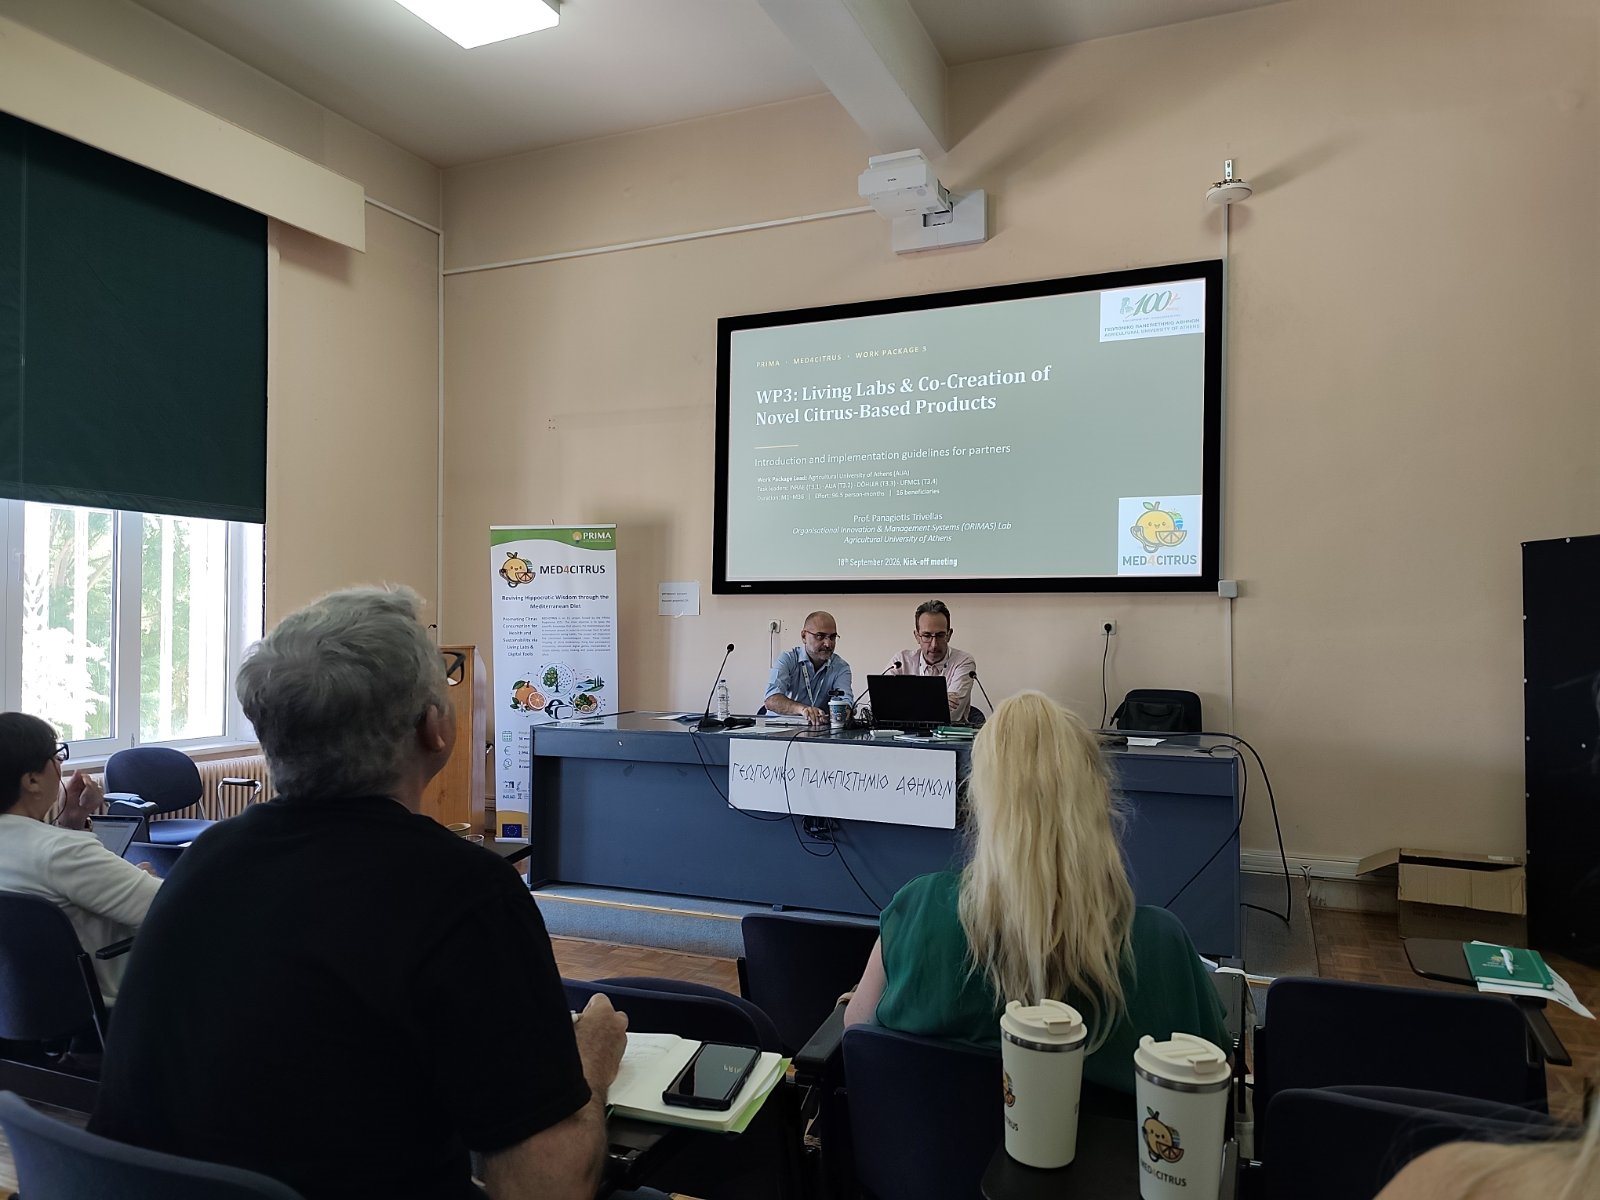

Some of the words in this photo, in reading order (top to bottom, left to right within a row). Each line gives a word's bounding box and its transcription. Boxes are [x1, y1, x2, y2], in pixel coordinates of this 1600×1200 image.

[856, 351, 880, 359] WORK
[882, 346, 919, 356] PACKAGE
[756, 388, 798, 404] WP3:
[802, 385, 852, 402] Living
[856, 380, 896, 397] Labs
[900, 378, 914, 393] &
[918, 370, 1026, 392] Co-Creation
[1031, 364, 1052, 382] of
[756, 409, 799, 426] Novel
[804, 400, 911, 422] Citrus-Based
[916, 395, 997, 414] Products
[754, 456, 807, 467] Introduction
[809, 454, 826, 464] and
[827, 450, 900, 464] implementation
[902, 448, 950, 460] guidelines
[952, 446, 967, 456] for
[968, 444, 1011, 457] partners
[808, 473, 838, 482] Agricultural
[854, 514, 870, 522] Prof.
[872, 514, 910, 522] Panagiotis
[912, 512, 943, 520] Trivellas
[792, 526, 840, 536] Organisational
[840, 526, 876, 534] Innovation
[884, 524, 930, 533] Management
[932, 524, 960, 532] Systems
[960, 522, 997, 532] (ORIMAS)
[998, 521, 1012, 530] Lab
[583, 532, 612, 540] PRIMA
[844, 536, 883, 544] Agricultural
[884, 535, 918, 544] University
[918, 534, 928, 544] of
[850, 558, 884, 568] September
[904, 557, 930, 566] Kick-off
[930, 557, 958, 568] meeting
[1122, 554, 1197, 566] MED4CITRUS
[540, 564, 606, 574] MED4CITRUS
[732, 762, 796, 784] ΓΕΩΠΟΝΙΚΟ
[800, 768, 888, 792] ΠΑΝΕΠΙΣΤΗΜΙΟ
[896, 776, 953, 799] ΑΘΗΝΩΝ
